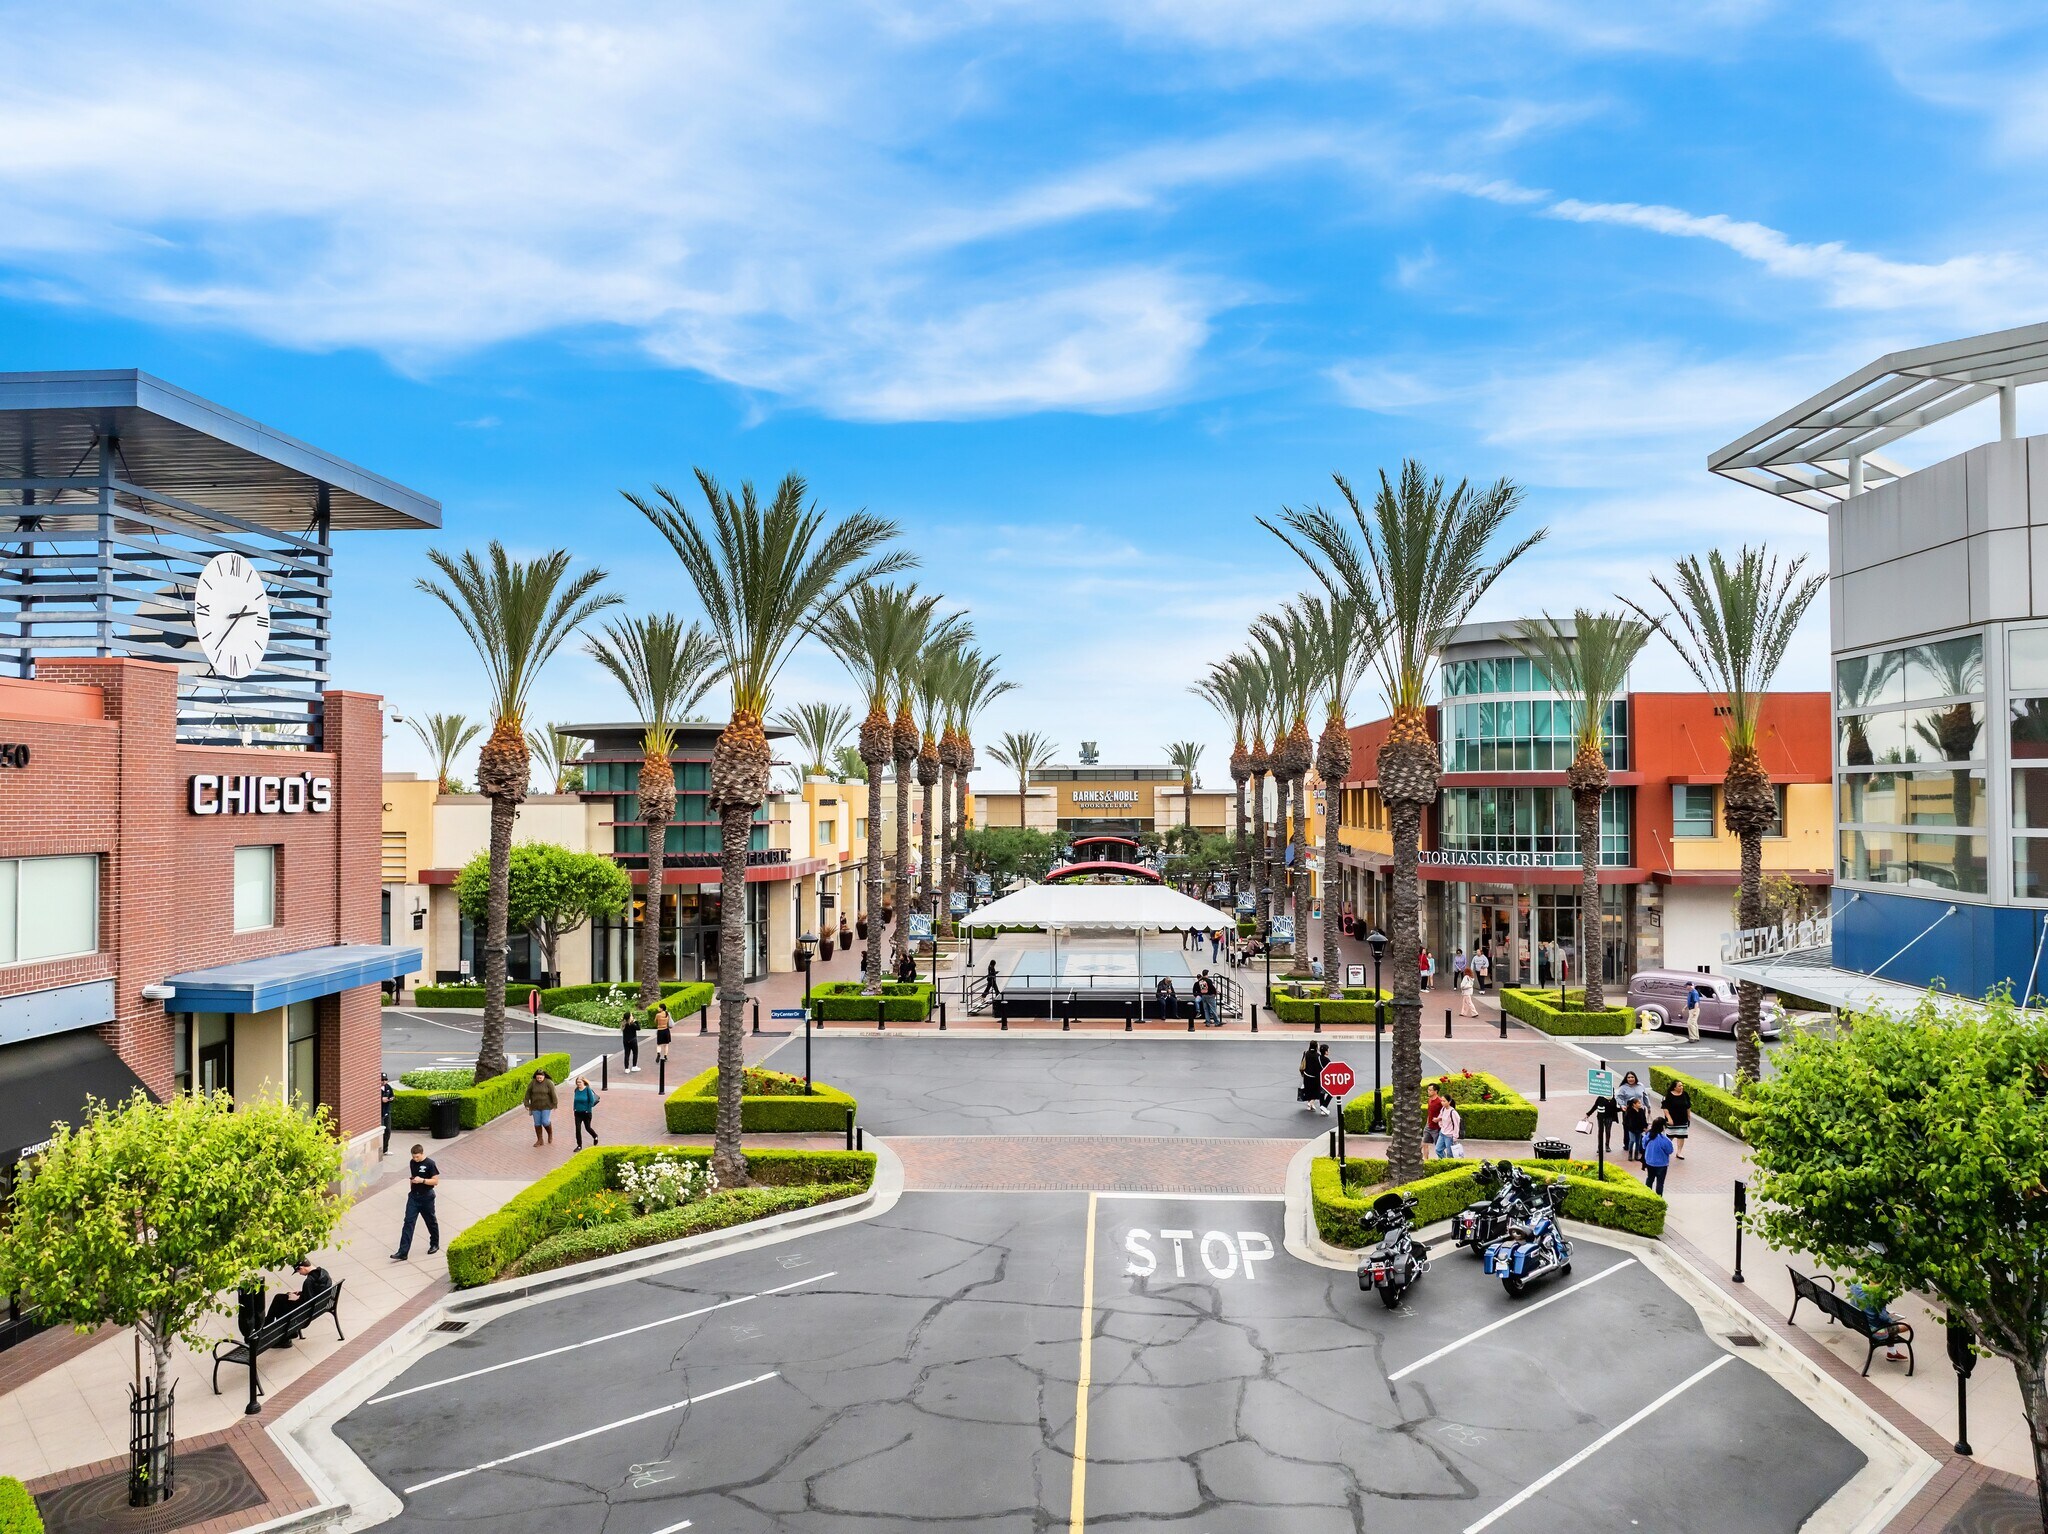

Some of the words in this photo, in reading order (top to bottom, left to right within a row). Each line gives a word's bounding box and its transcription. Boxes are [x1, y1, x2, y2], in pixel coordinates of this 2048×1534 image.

[0, 743, 30, 768] 50
[191, 771, 332, 815] CHICO'S
[747, 849, 791, 866] EPUBLIC
[1417, 850, 1478, 866] CTORIA'S
[1486, 853, 1554, 867] SECRET
[1324, 1073, 1350, 1086] STOP
[1125, 1229, 1274, 1280] STOP
